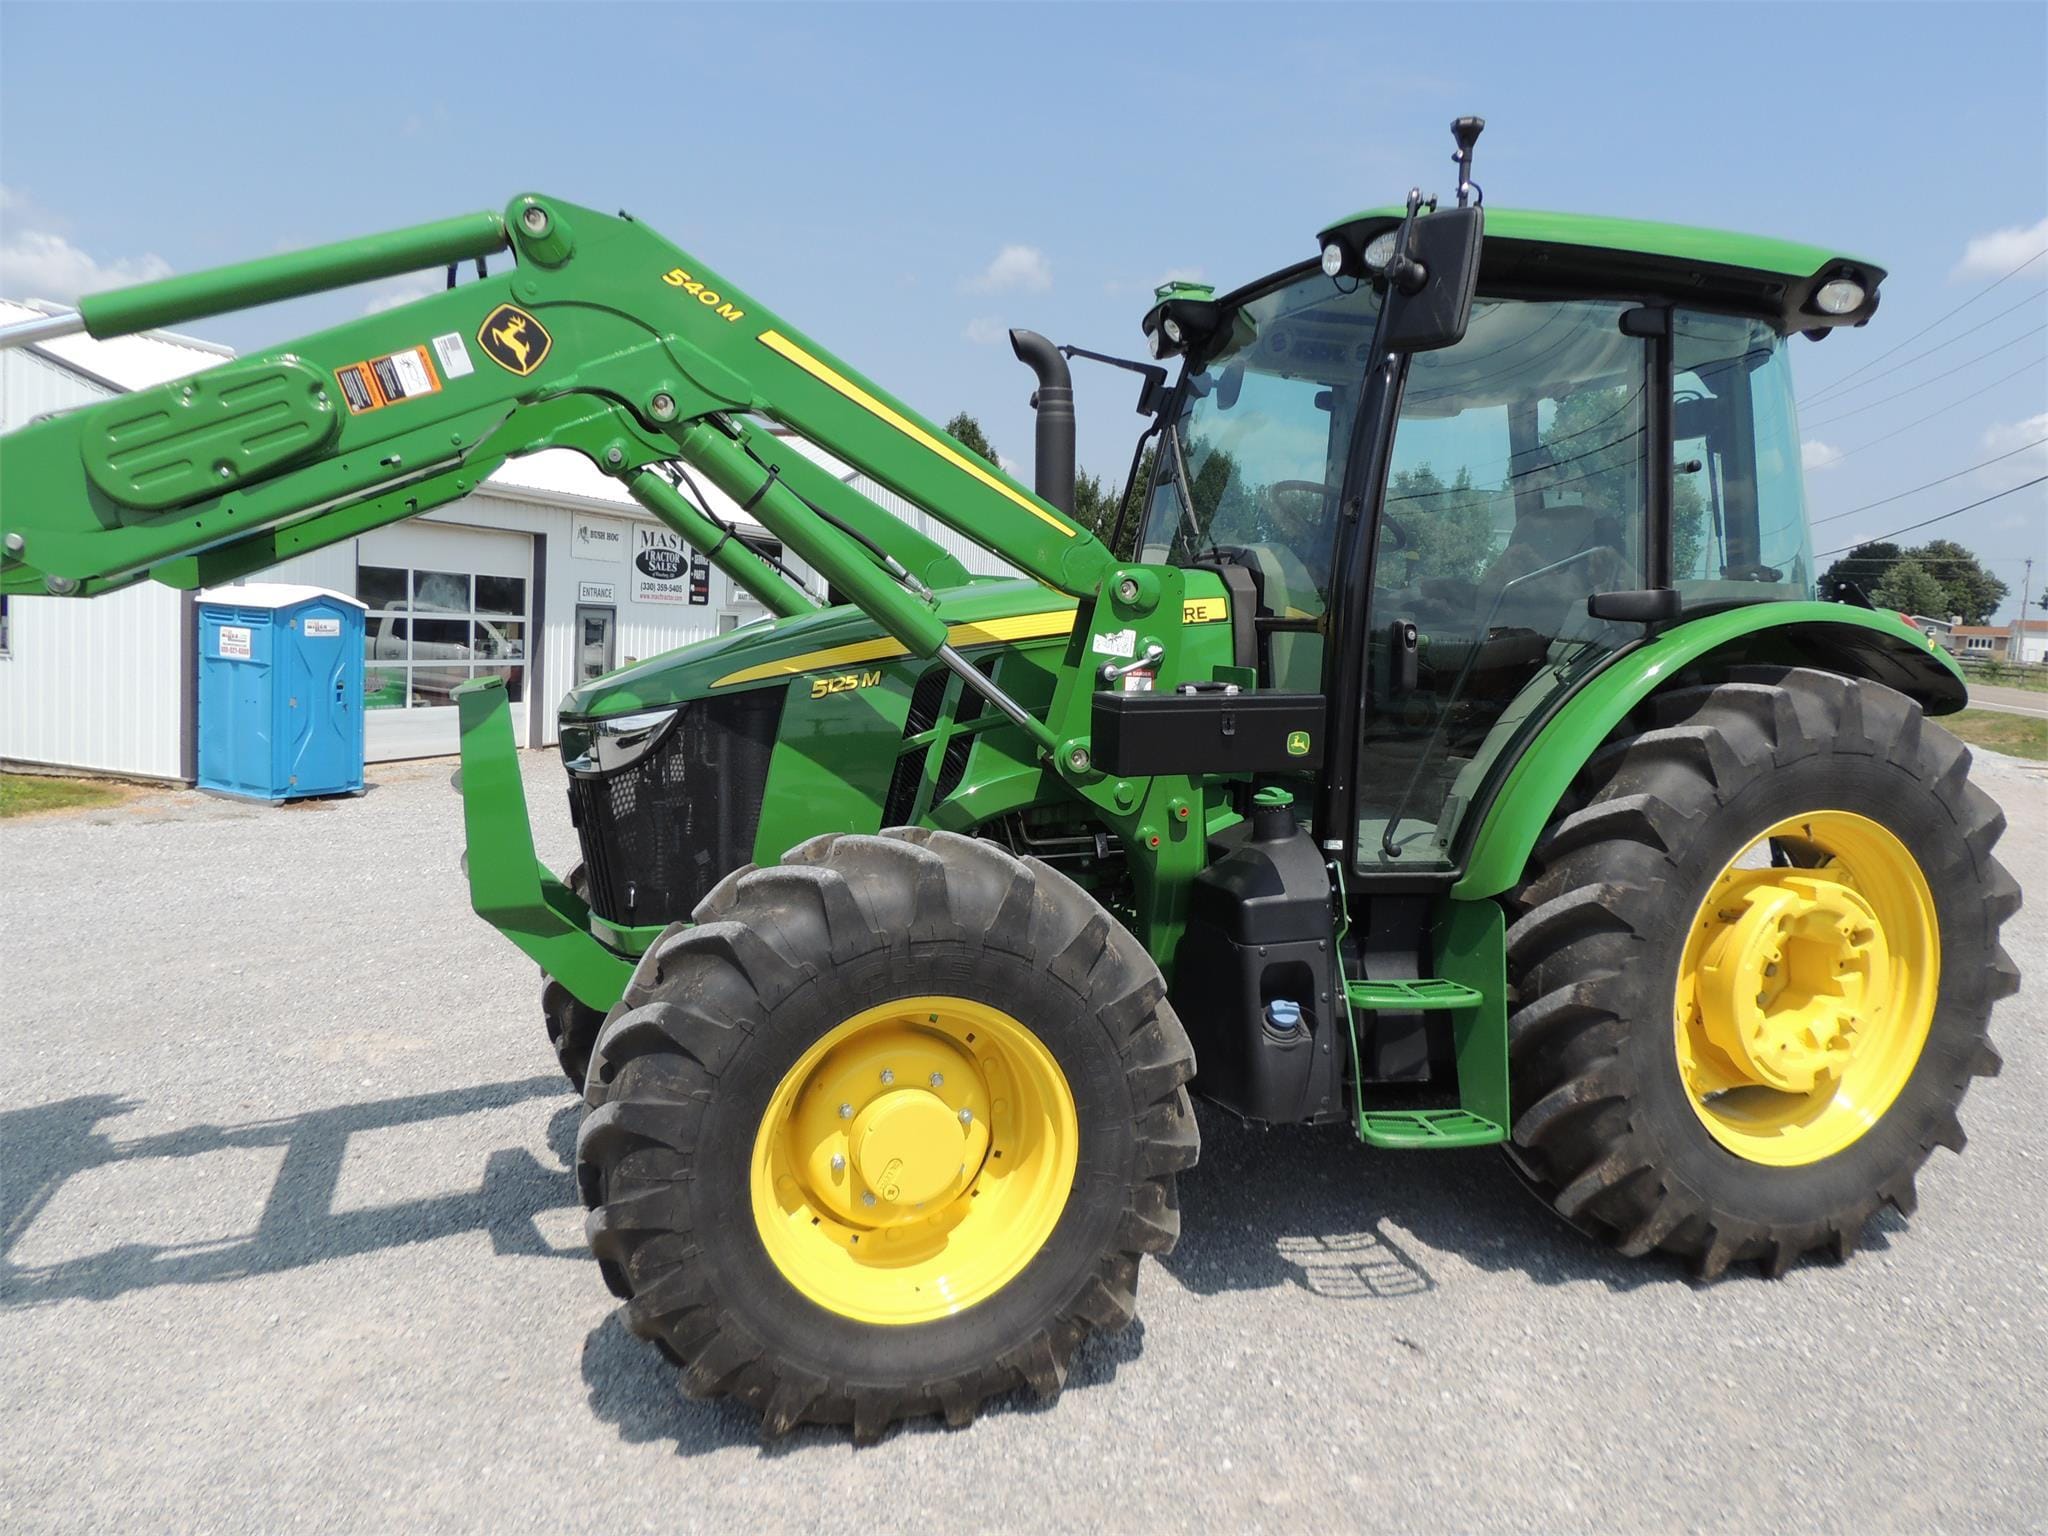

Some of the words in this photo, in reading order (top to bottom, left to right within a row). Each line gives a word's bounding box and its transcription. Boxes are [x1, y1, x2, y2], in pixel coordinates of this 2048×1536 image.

[606, 532, 619, 542] HOG
[640, 530, 685, 551] MAST
[644, 549, 680, 563] TRACTOR
[649, 561, 678, 572] SALES
[582, 587, 612, 599] ENTRANCE
